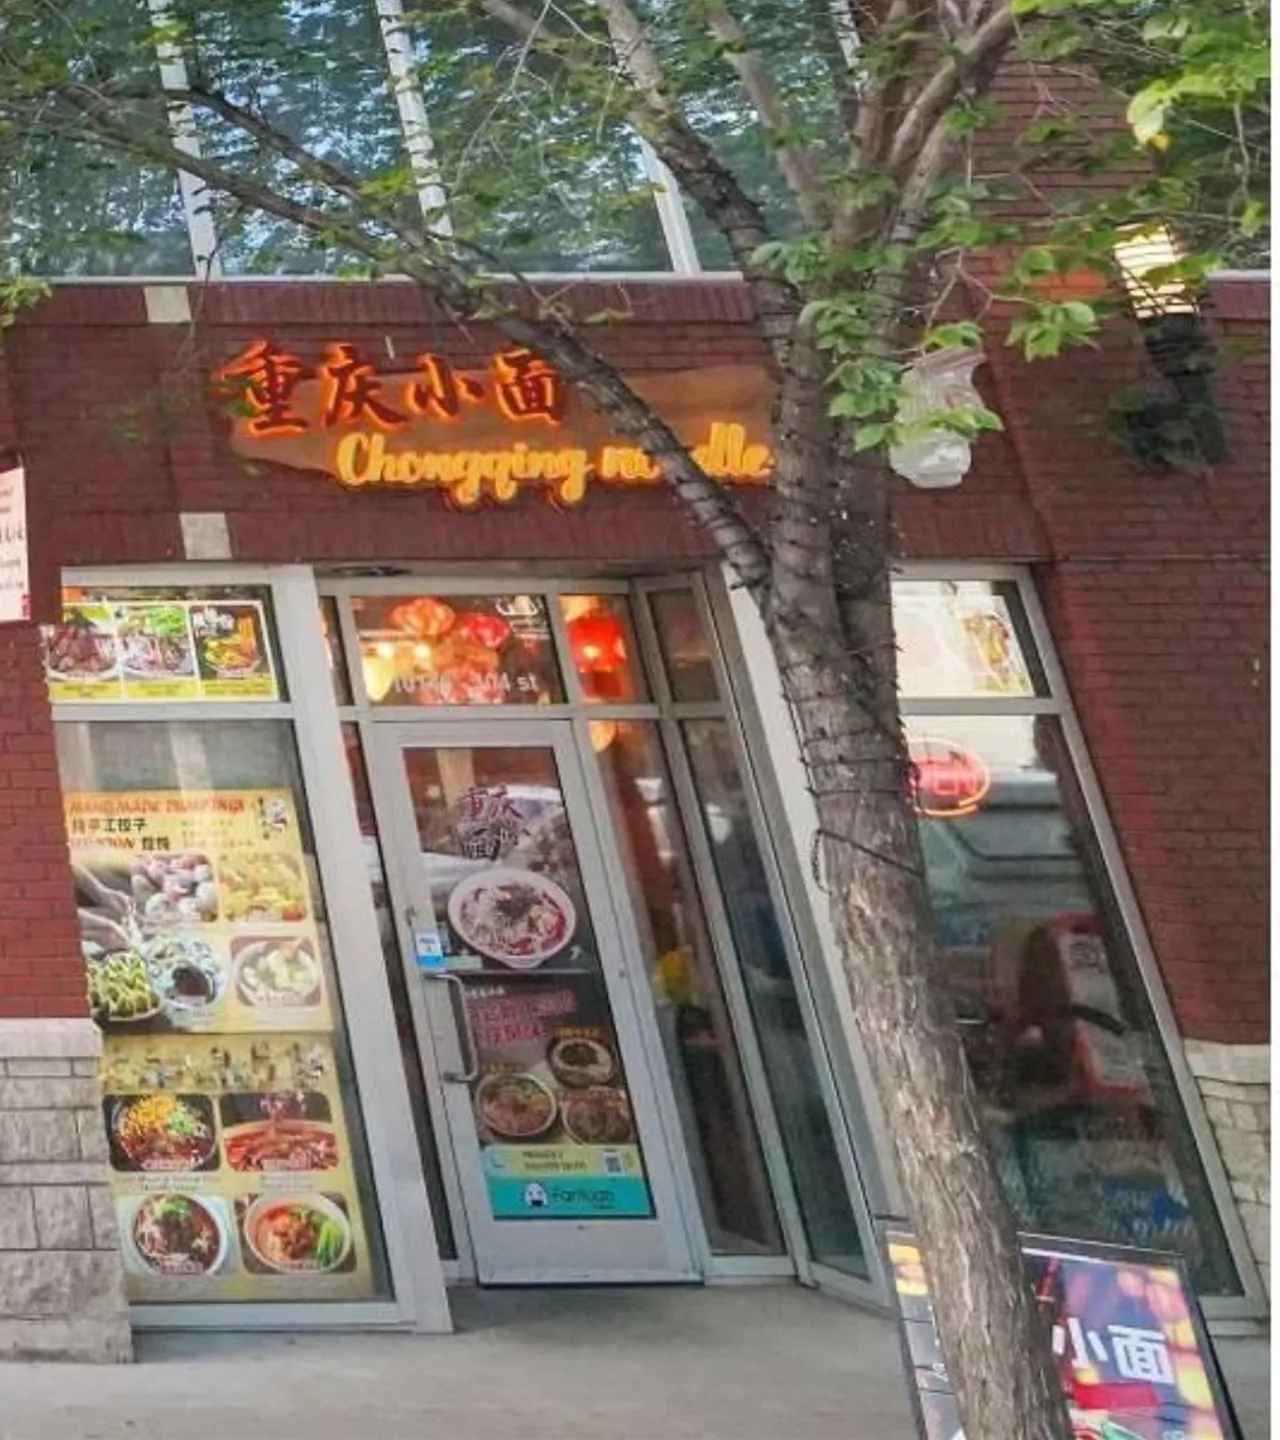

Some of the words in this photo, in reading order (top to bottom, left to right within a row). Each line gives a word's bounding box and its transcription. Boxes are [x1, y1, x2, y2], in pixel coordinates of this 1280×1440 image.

[216, 339, 565, 435] 重庆小面
[338, 432, 594, 503] Chongqing
[602, 422, 776, 479] nodle
[1052, 1317, 1176, 1385] 小面
